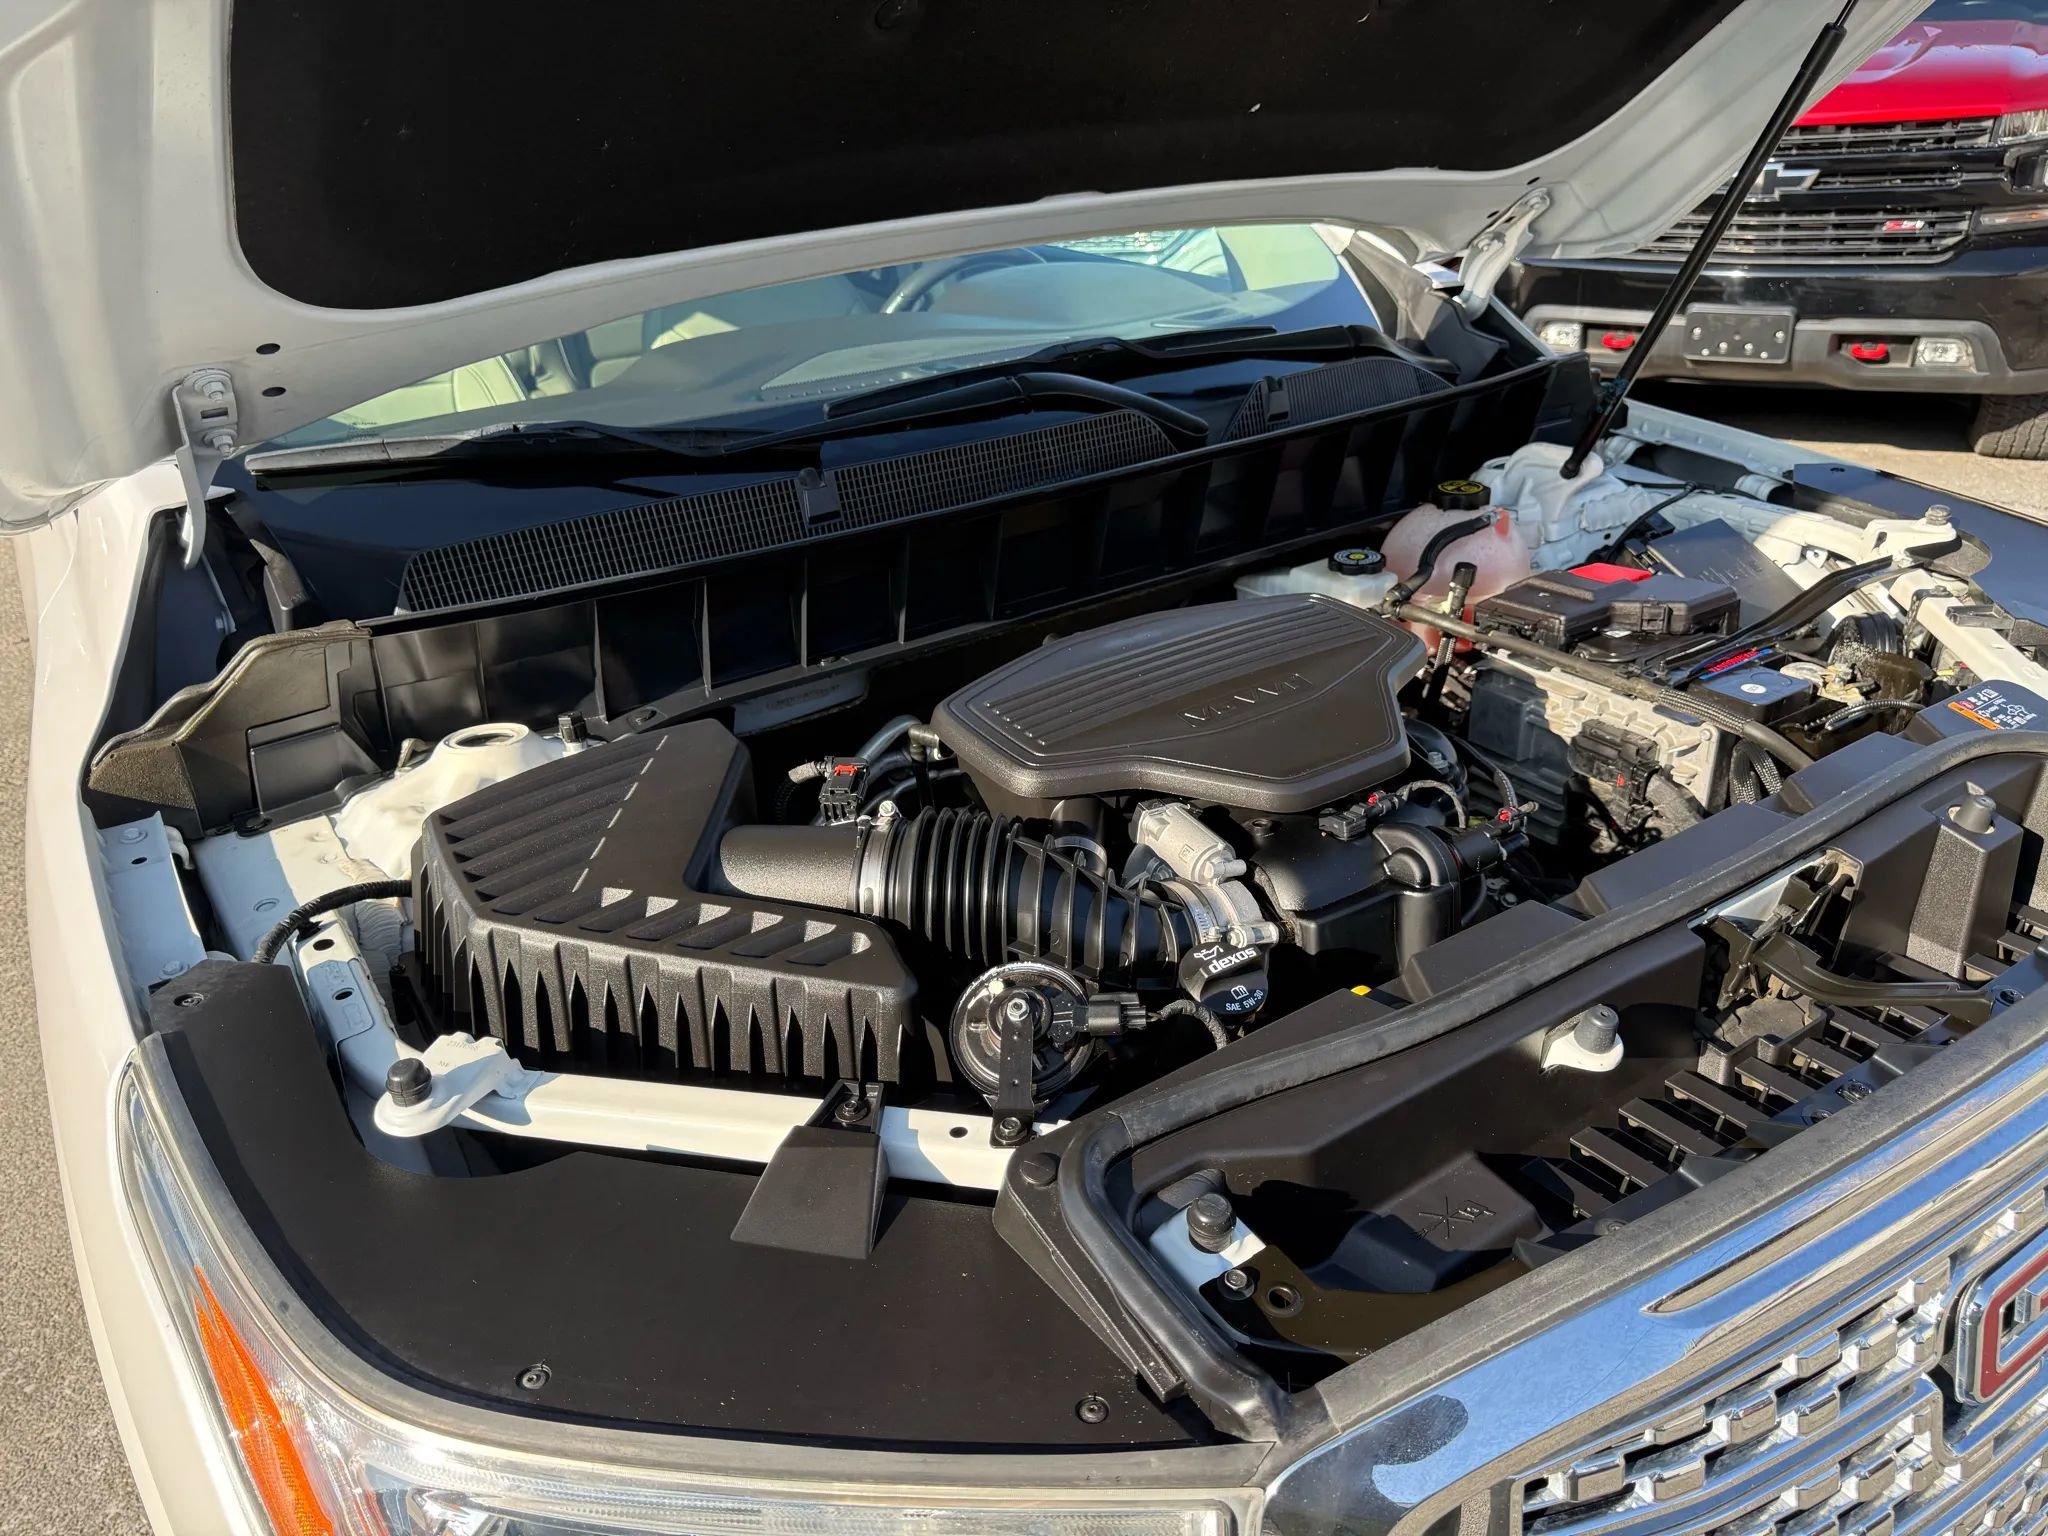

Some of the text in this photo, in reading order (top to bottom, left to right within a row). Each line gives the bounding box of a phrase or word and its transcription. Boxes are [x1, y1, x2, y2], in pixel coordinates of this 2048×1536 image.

[1208, 947, 1257, 974] dexos
[1225, 989, 1264, 1011] SAE 5W-30
